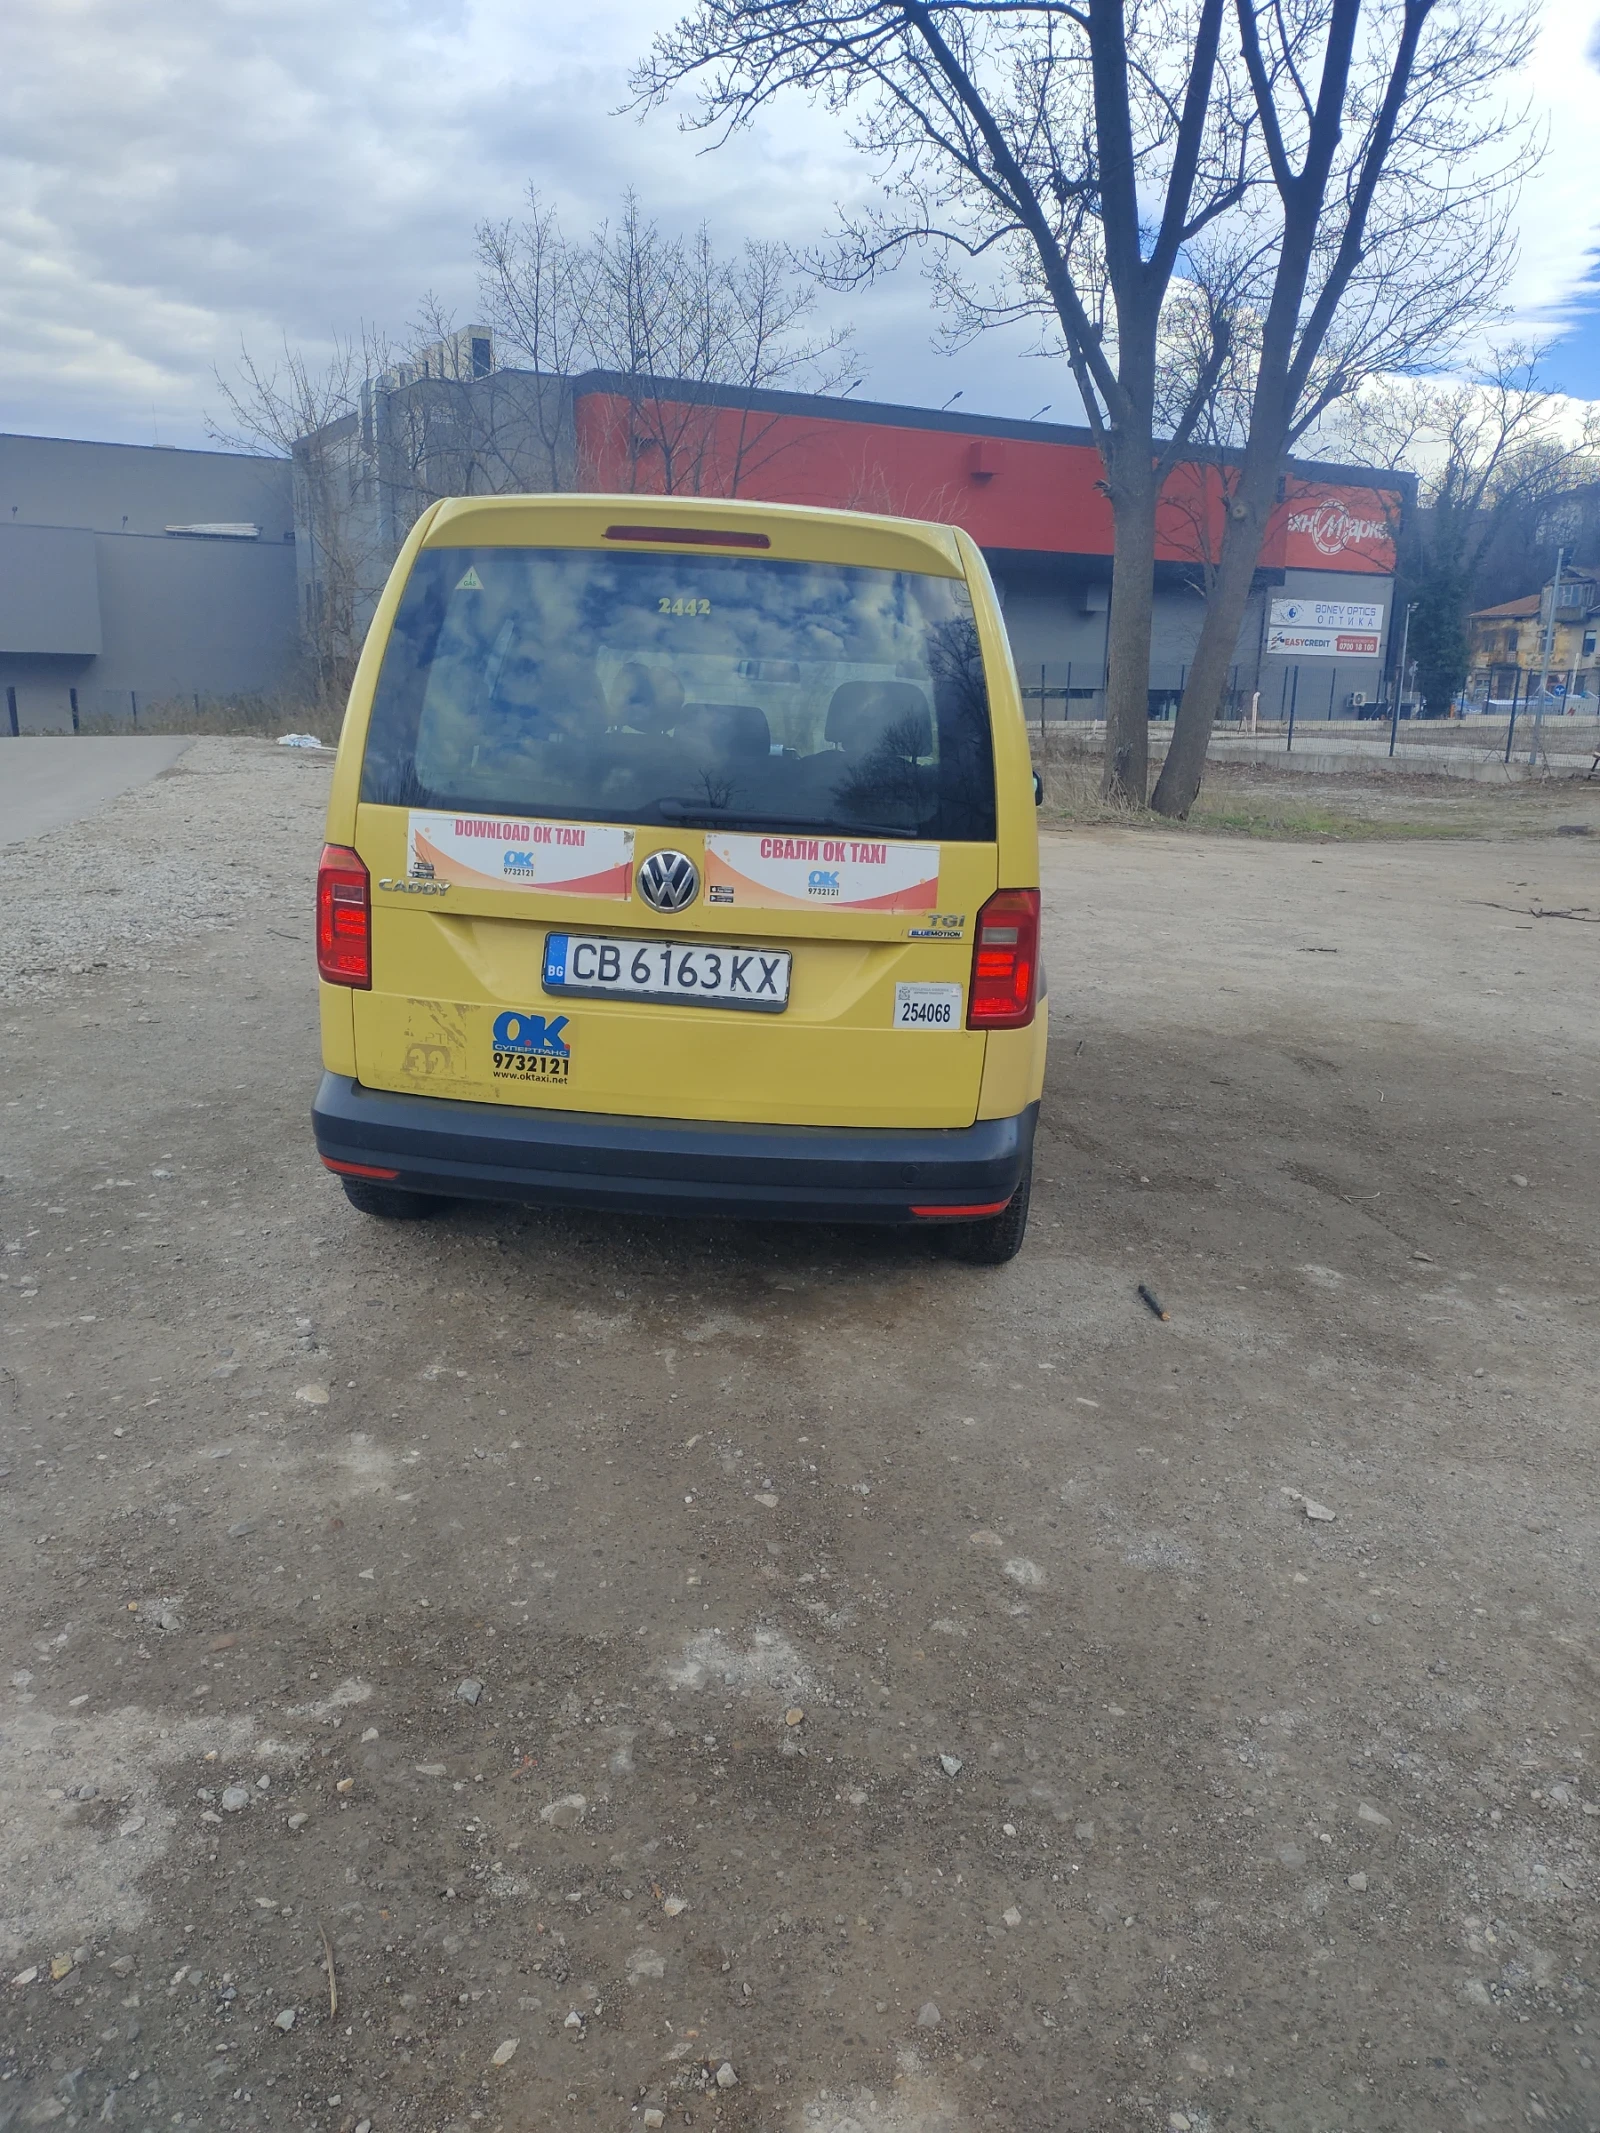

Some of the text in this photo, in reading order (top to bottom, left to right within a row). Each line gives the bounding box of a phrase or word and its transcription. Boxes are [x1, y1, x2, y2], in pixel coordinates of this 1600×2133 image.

[658, 597, 711, 616] 2442
[1315, 604, 1376, 617] BONEV OPTICS
[1317, 615, 1373, 627] ОПТИКА
[1285, 638, 1331, 648] EASYCREDIT
[1339, 642, 1354, 651] 0700
[455, 819, 586, 847] DOWNLOAD OK TAXI
[760, 838, 819, 862] СВАЛИ
[850, 843, 887, 864] TAXI
[504, 867, 534, 877] 9732121
[378, 878, 452, 897] CADDY
[808, 887, 839, 896] 9732121
[547, 965, 564, 977] BG
[902, 1002, 951, 1022] 254068
[494, 1043, 568, 1057] СУПЕРТРАНС
[493, 1052, 569, 1076] 9732121
[493, 1070, 568, 1085] www.oktaxi.net
